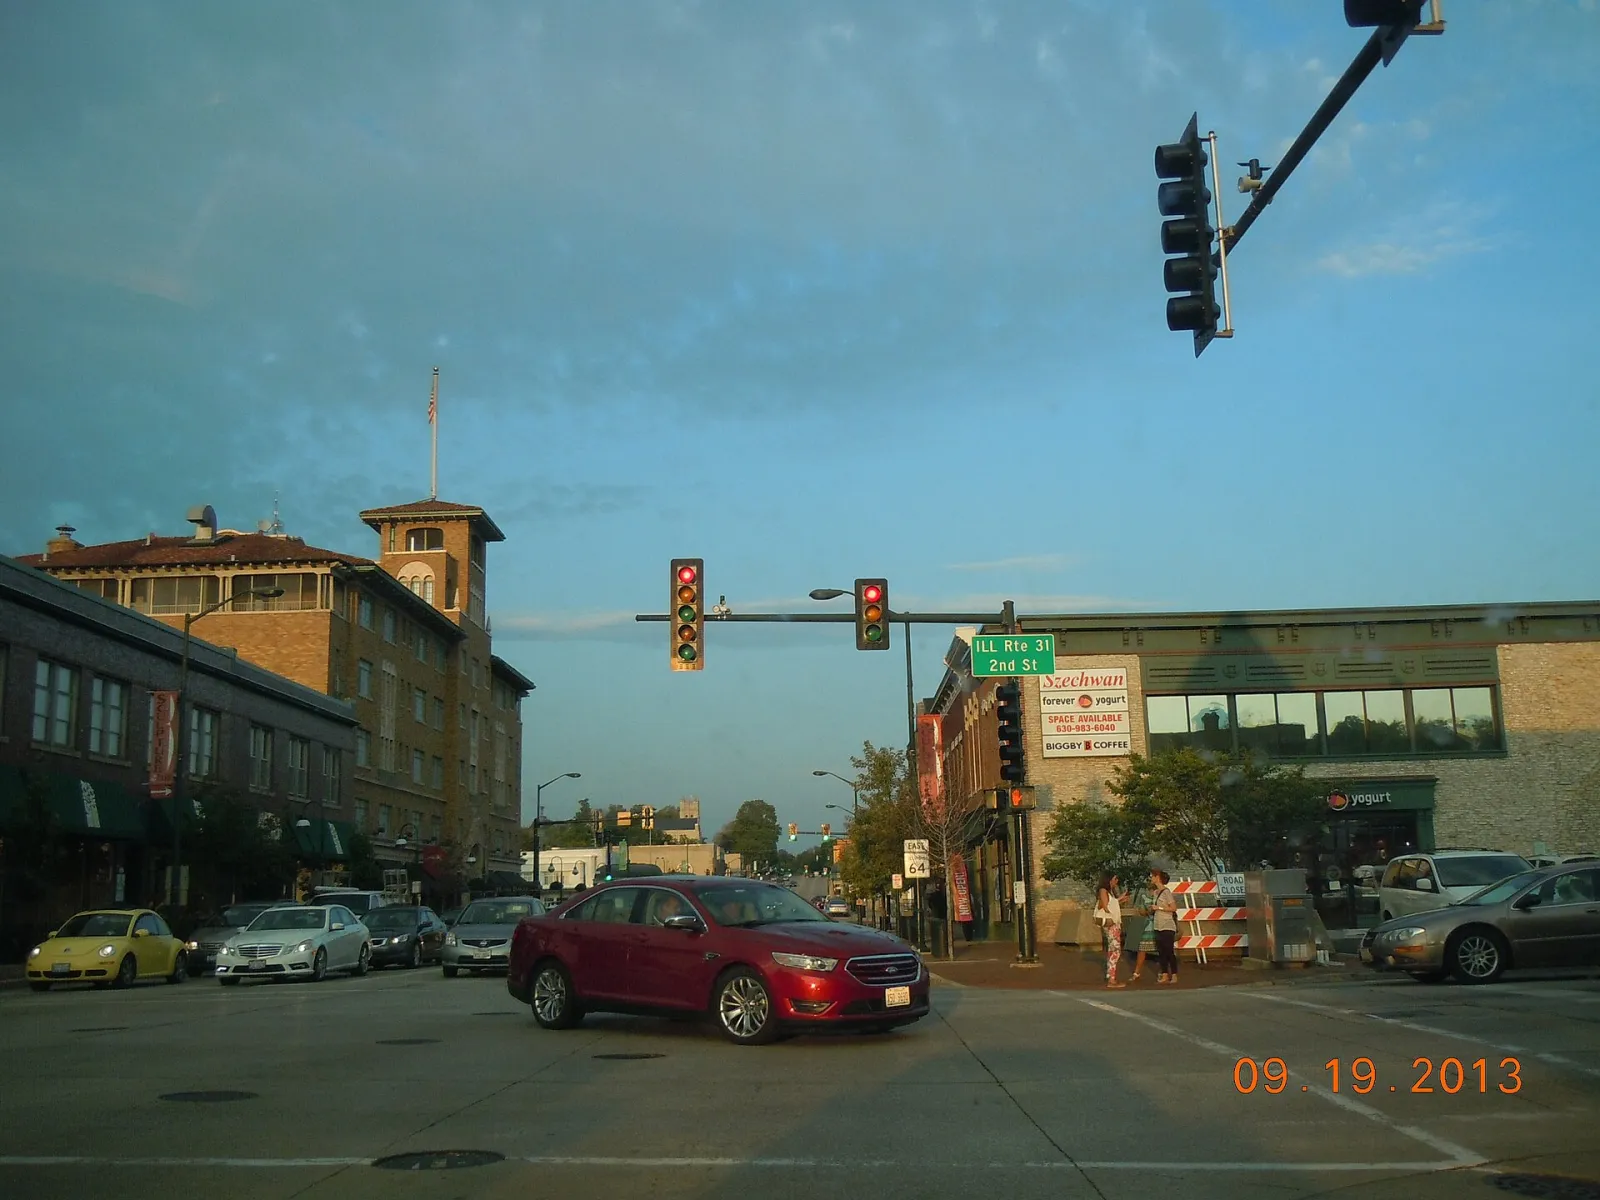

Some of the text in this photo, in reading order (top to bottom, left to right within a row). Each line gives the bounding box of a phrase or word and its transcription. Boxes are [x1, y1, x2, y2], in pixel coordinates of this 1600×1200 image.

[976, 639, 1050, 653] ILL Rte 31
[989, 658, 1038, 672] 2nd St
[1043, 671, 1124, 689] Szechwan
[1042, 695, 1127, 706] forever yogurt
[1048, 714, 1123, 724] SPACE AVAILABLE
[1056, 724, 1116, 733] 630-983-6040
[1046, 742, 1082, 751] BIGGBY
[1093, 741, 1128, 749] COFFEE
[1351, 792, 1391, 806] yogurt
[908, 842, 926, 850] EAST
[909, 863, 926, 874] 64
[1223, 876, 1244, 884] ROAD
[1221, 886, 1246, 895] CLOSE
[958, 897, 971, 916] NOW
